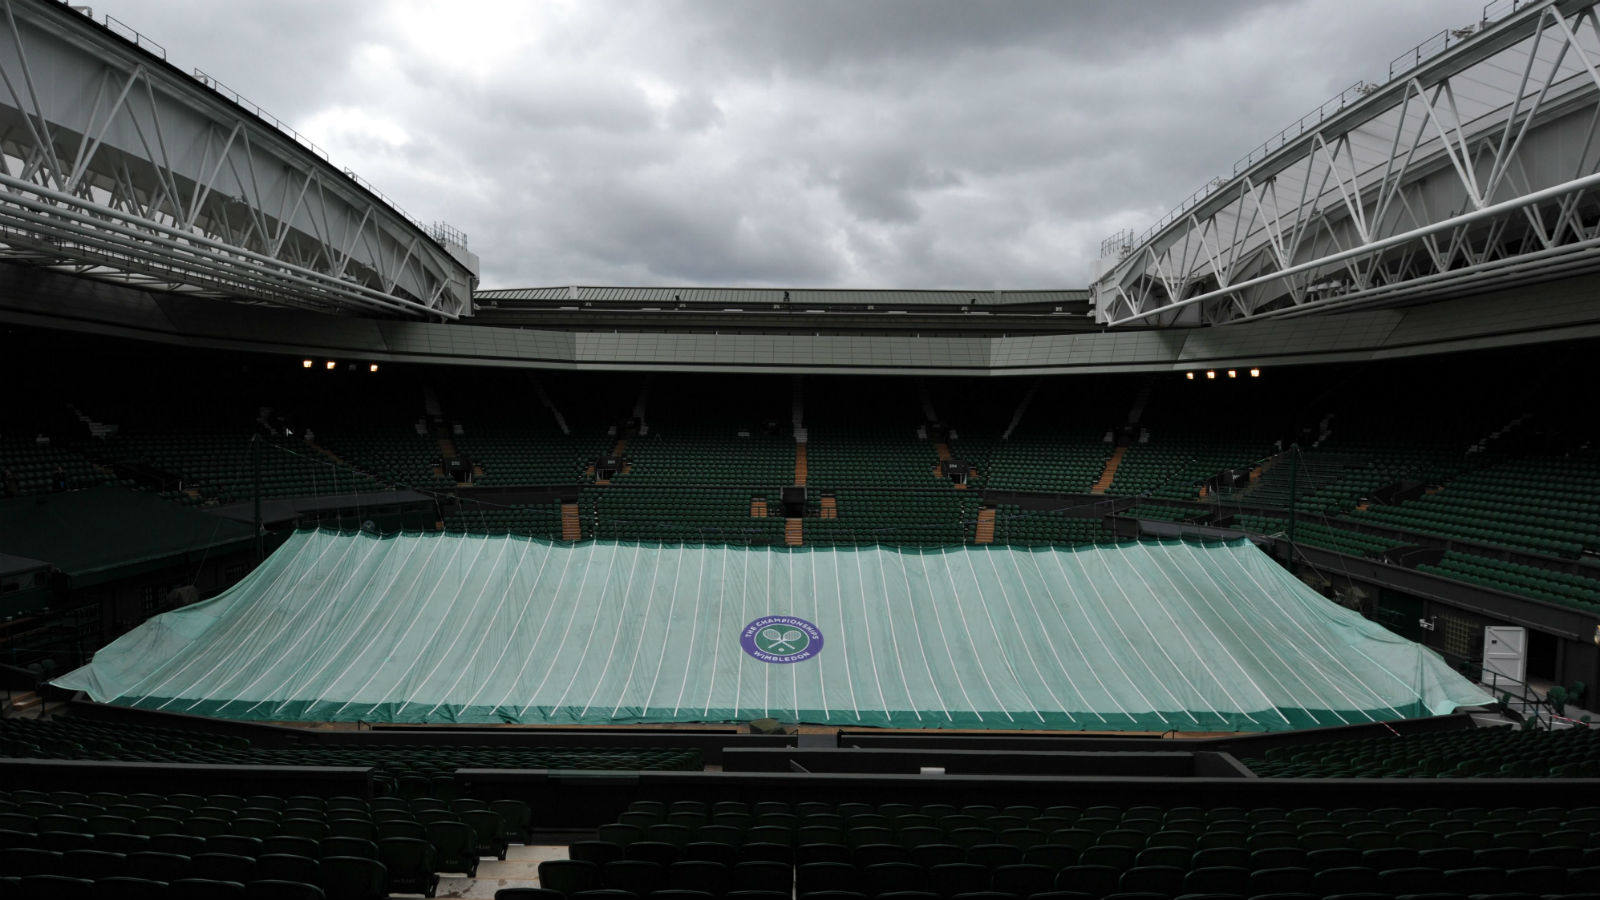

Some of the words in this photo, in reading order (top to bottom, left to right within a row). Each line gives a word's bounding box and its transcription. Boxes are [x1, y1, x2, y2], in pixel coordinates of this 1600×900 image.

[745, 626, 757, 638] THE
[755, 618, 819, 640] CHAMPIONSHIPS
[754, 651, 811, 662] WIMBLEDON
